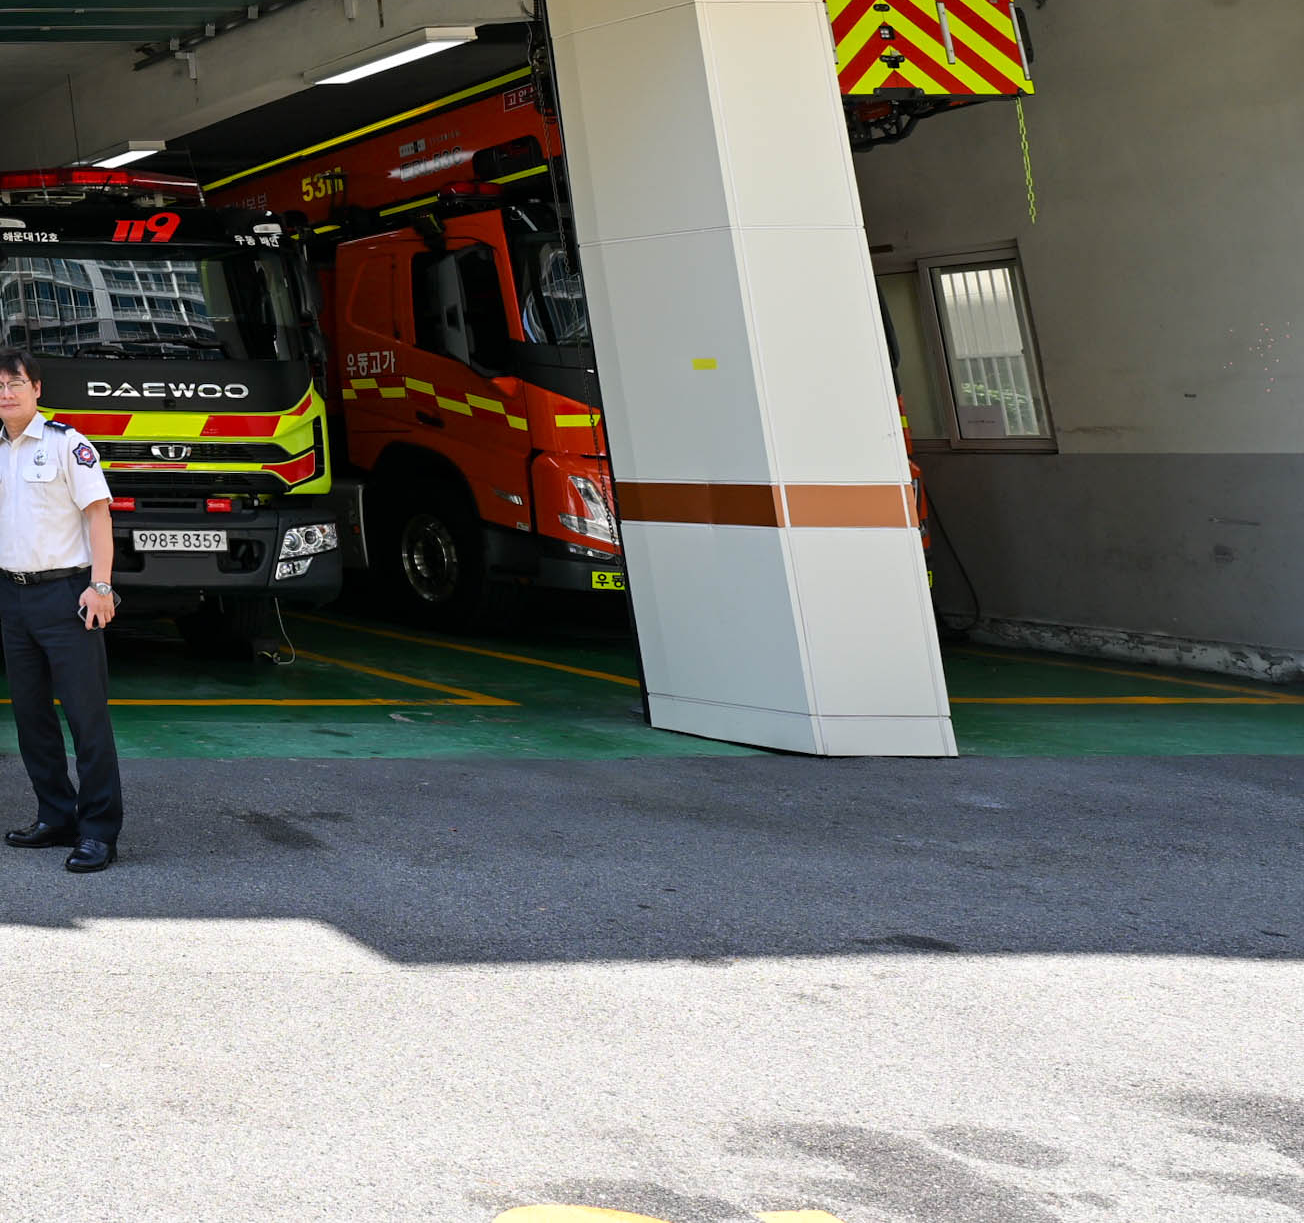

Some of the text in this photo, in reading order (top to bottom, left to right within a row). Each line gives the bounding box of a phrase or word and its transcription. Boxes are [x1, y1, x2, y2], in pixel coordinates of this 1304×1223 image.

[111, 211, 182, 242] 119
[2, 231, 60, 243] 해운대12호
[346, 350, 396, 377] 우동고가
[87, 381, 249, 399] DAEWOO
[139, 533, 222, 548] 998주 8359
